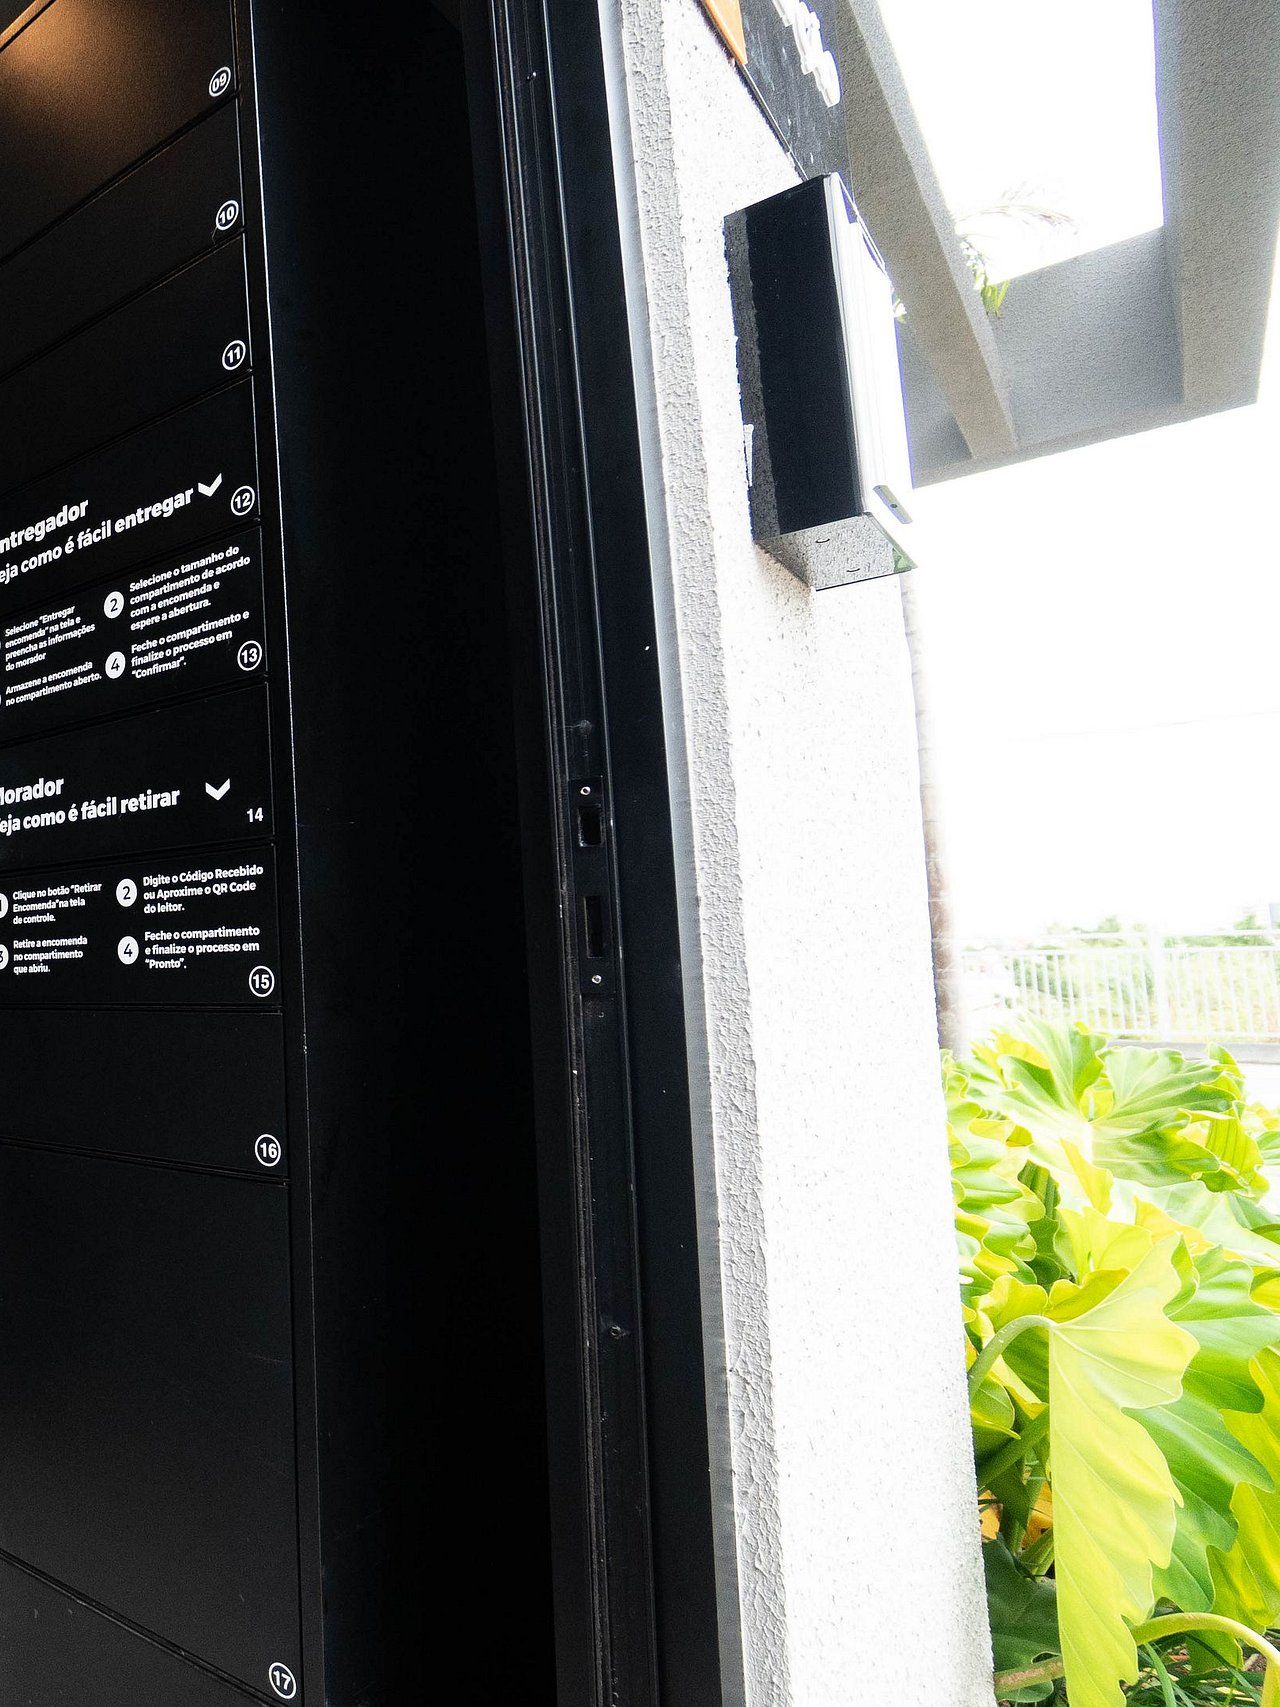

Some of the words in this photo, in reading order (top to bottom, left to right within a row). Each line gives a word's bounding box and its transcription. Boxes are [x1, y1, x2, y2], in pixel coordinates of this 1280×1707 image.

[20, 546, 63, 574] como
[64, 537, 75, 555] é
[77, 520, 112, 551] fácil
[114, 487, 194, 533] entregar
[129, 572, 172, 592] Selecione
[173, 568, 180, 576] o
[180, 552, 224, 573] tamanho
[225, 545, 240, 558] do
[129, 574, 201, 605] compartimento
[201, 568, 214, 579] de
[215, 555, 251, 575] acordo
[130, 605, 150, 618] com
[150, 603, 157, 611] a
[157, 583, 213, 609] encomenda
[213, 580, 220, 589] e
[130, 615, 161, 631] espere
[161, 612, 168, 621] a
[168, 598, 212, 619] abertura.
[4, 619, 39, 637] Selecione
[49, 624, 60, 634] na
[60, 618, 75, 629] tela
[75, 616, 81, 624] e
[131, 636, 158, 654] Feche
[158, 636, 166, 645] o
[166, 613, 242, 643] compartimento
[242, 610, 250, 619] e
[5, 642, 38, 662] preencha
[38, 640, 48, 649] as
[48, 623, 96, 646] informações
[131, 648, 164, 667] finalize
[165, 648, 172, 657] o
[173, 635, 215, 657] processo
[216, 630, 233, 642] em
[5, 662, 15, 672] do
[15, 652, 47, 669] morador
[5, 677, 42, 695] Armazene
[47, 661, 93, 681] encomenda
[5, 698, 15, 707] no
[15, 681, 73, 704] compartimento
[73, 672, 102, 686] aberto.
[22, 810, 66, 831] como
[67, 803, 79, 822] é
[80, 796, 117, 820] fácil
[120, 788, 181, 814] retirar
[246, 807, 264, 823] 14
[142, 874, 171, 887] Digite
[171, 874, 179, 884] o
[179, 868, 214, 884] Código
[215, 864, 264, 879] Recebido
[12, 890, 36, 901] Clique
[37, 890, 47, 898] no
[47, 886, 70, 897] botão
[143, 890, 155, 901] ou
[156, 885, 203, 901] Aproxime
[204, 885, 211, 894] o
[212, 883, 228, 896] QR
[229, 880, 257, 892] Code
[69, 897, 86, 907] tela
[144, 903, 156, 914] do
[157, 902, 186, 913] leitor.
[13, 916, 23, 925] de
[23, 913, 56, 924] controle.
[13, 939, 36, 949] Retire
[36, 940, 41, 948] a
[42, 935, 88, 947] encomenda
[144, 931, 172, 941] Feche
[173, 930, 180, 940] o
[181, 926, 261, 941] compartimento
[13, 953, 23, 961] no
[23, 949, 84, 962] compartimento
[145, 945, 151, 955] e
[151, 943, 187, 954] finalize
[187, 943, 195, 953] o
[196, 942, 241, 955] processo
[241, 941, 260, 952] em
[13, 965, 28, 976] que
[28, 963, 51, 973] abriu.
